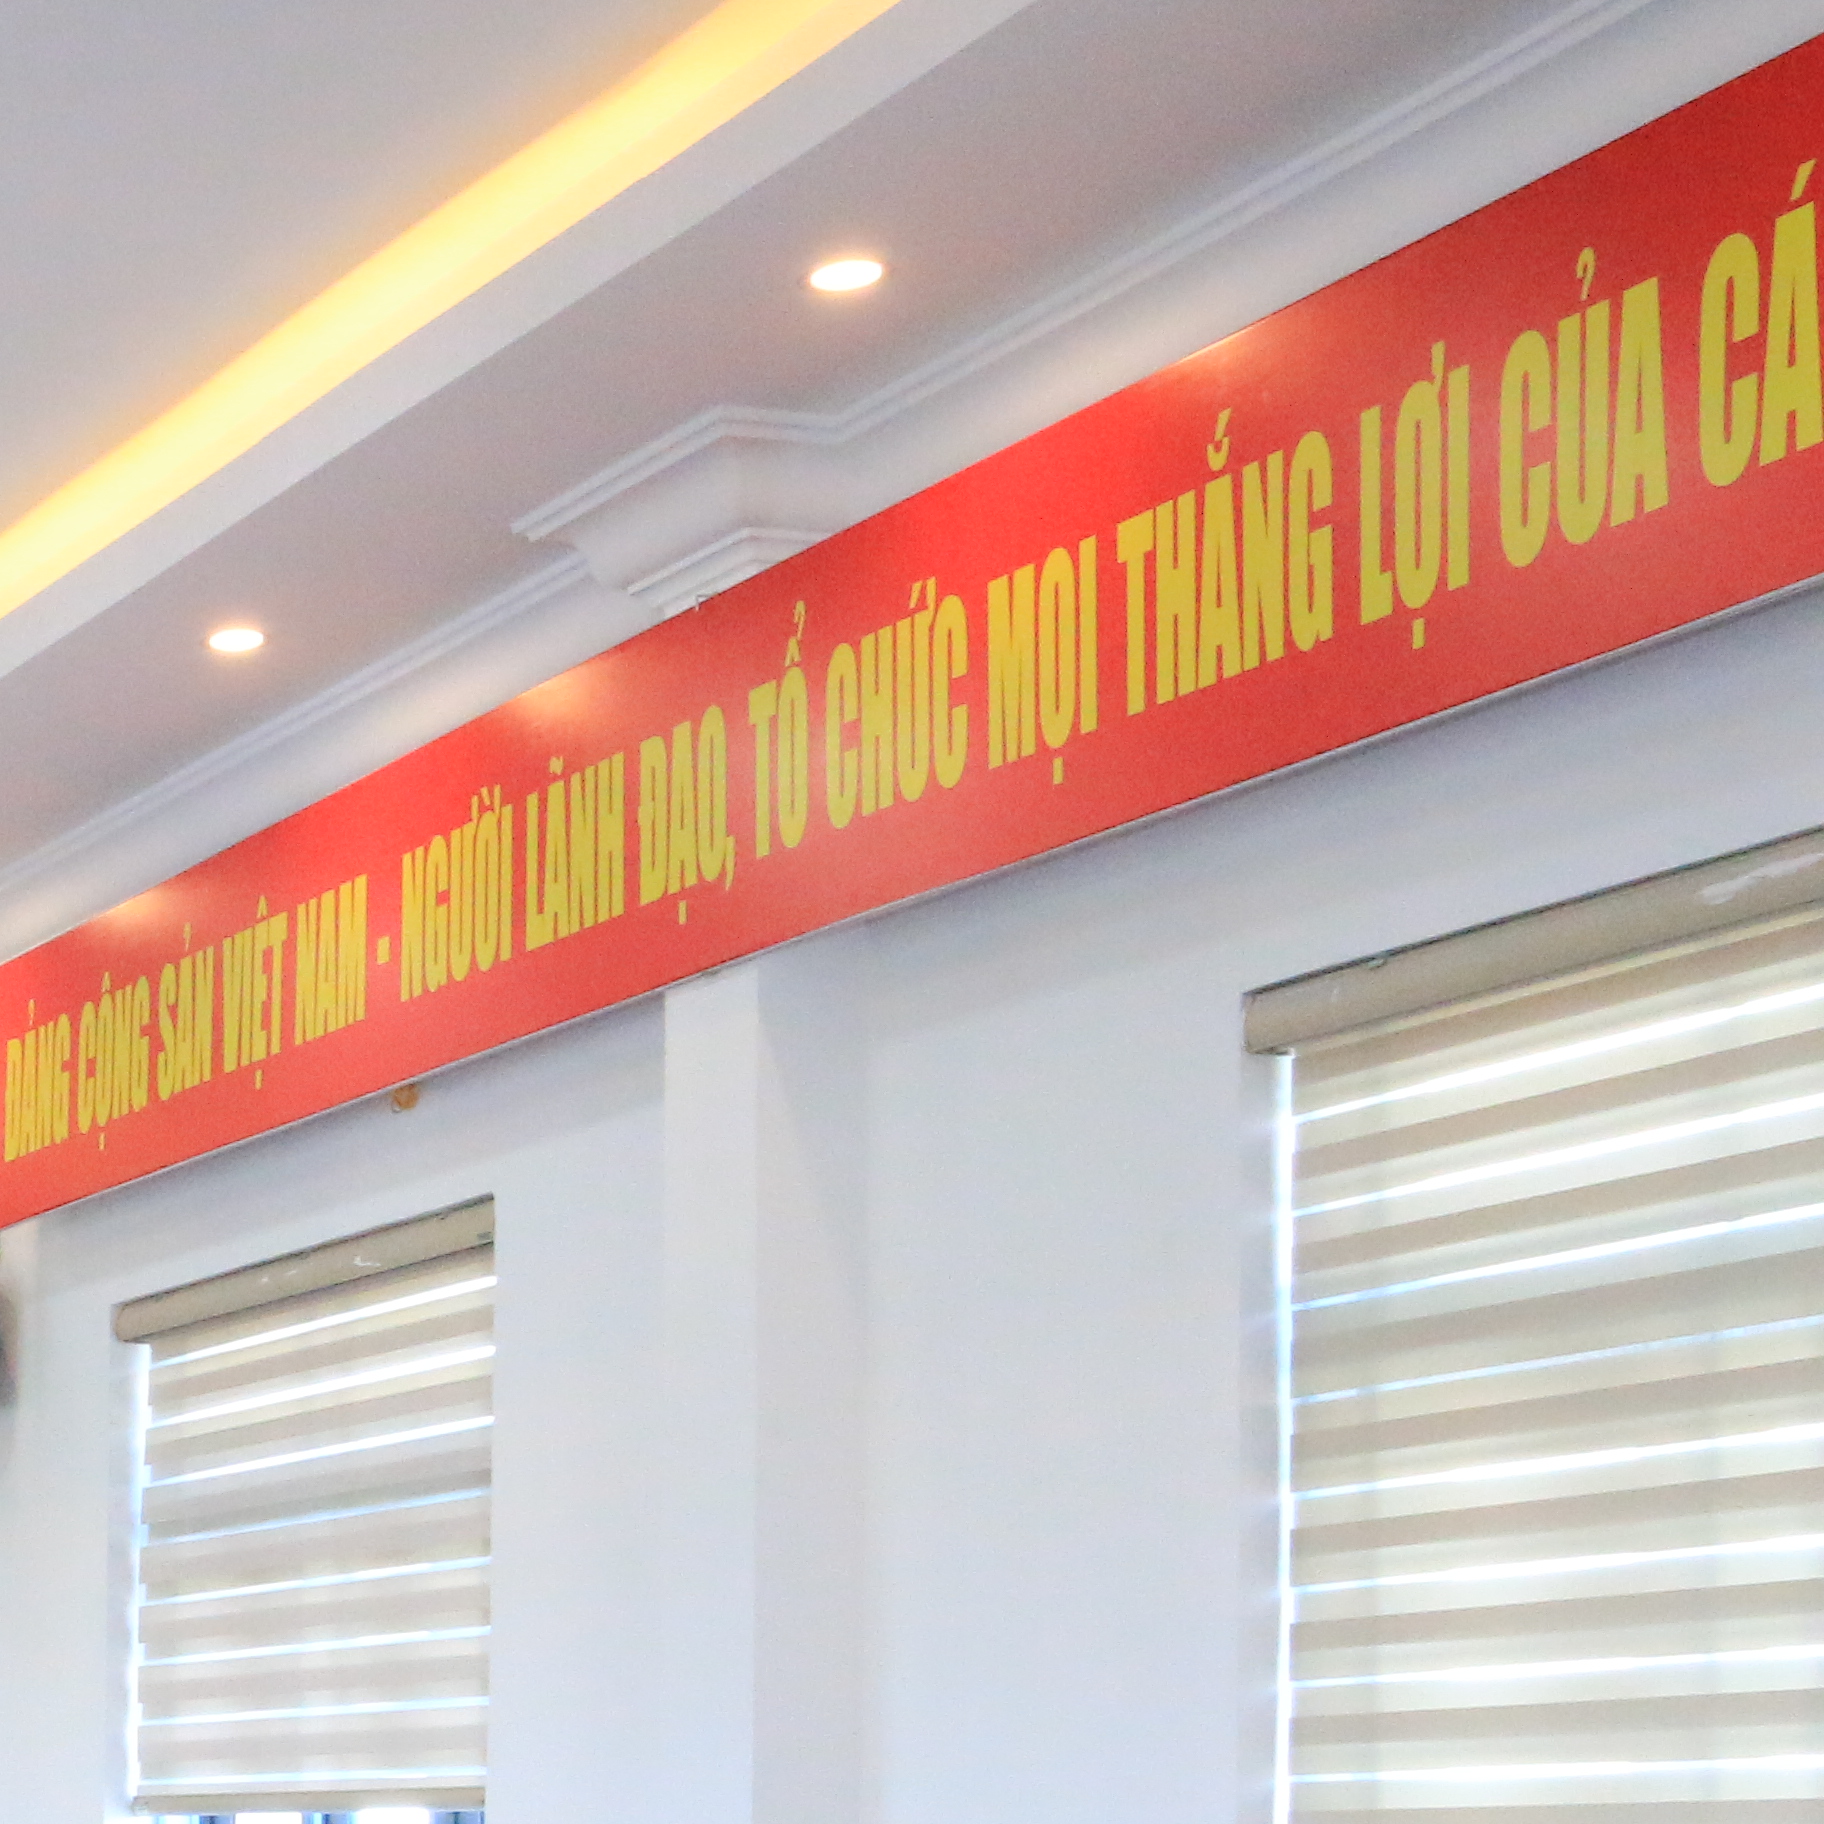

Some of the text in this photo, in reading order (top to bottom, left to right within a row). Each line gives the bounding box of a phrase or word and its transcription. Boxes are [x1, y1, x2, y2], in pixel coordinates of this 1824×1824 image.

[4, 999, 71, 1162] ĐẢNG
[77, 973, 151, 1150] CỘNG
[157, 921, 214, 1102] SẢN
[222, 896, 289, 1090] VIỆT
[294, 873, 368, 1045] NAM
[400, 784, 513, 1002] NGƯỜI
[525, 756, 625, 953] LÃNH
[638, 705, 736, 925] ĐẠO,
[749, 600, 809, 860] TỔ
[826, 577, 968, 829] CHỨC
[987, 535, 1097, 785] MỌI
[1117, 407, 1335, 716] THẮNG
[1359, 340, 1471, 650] LỢI
[1499, 246, 1669, 568] CỦA
[1699, 158, 1824, 486] CÁ
